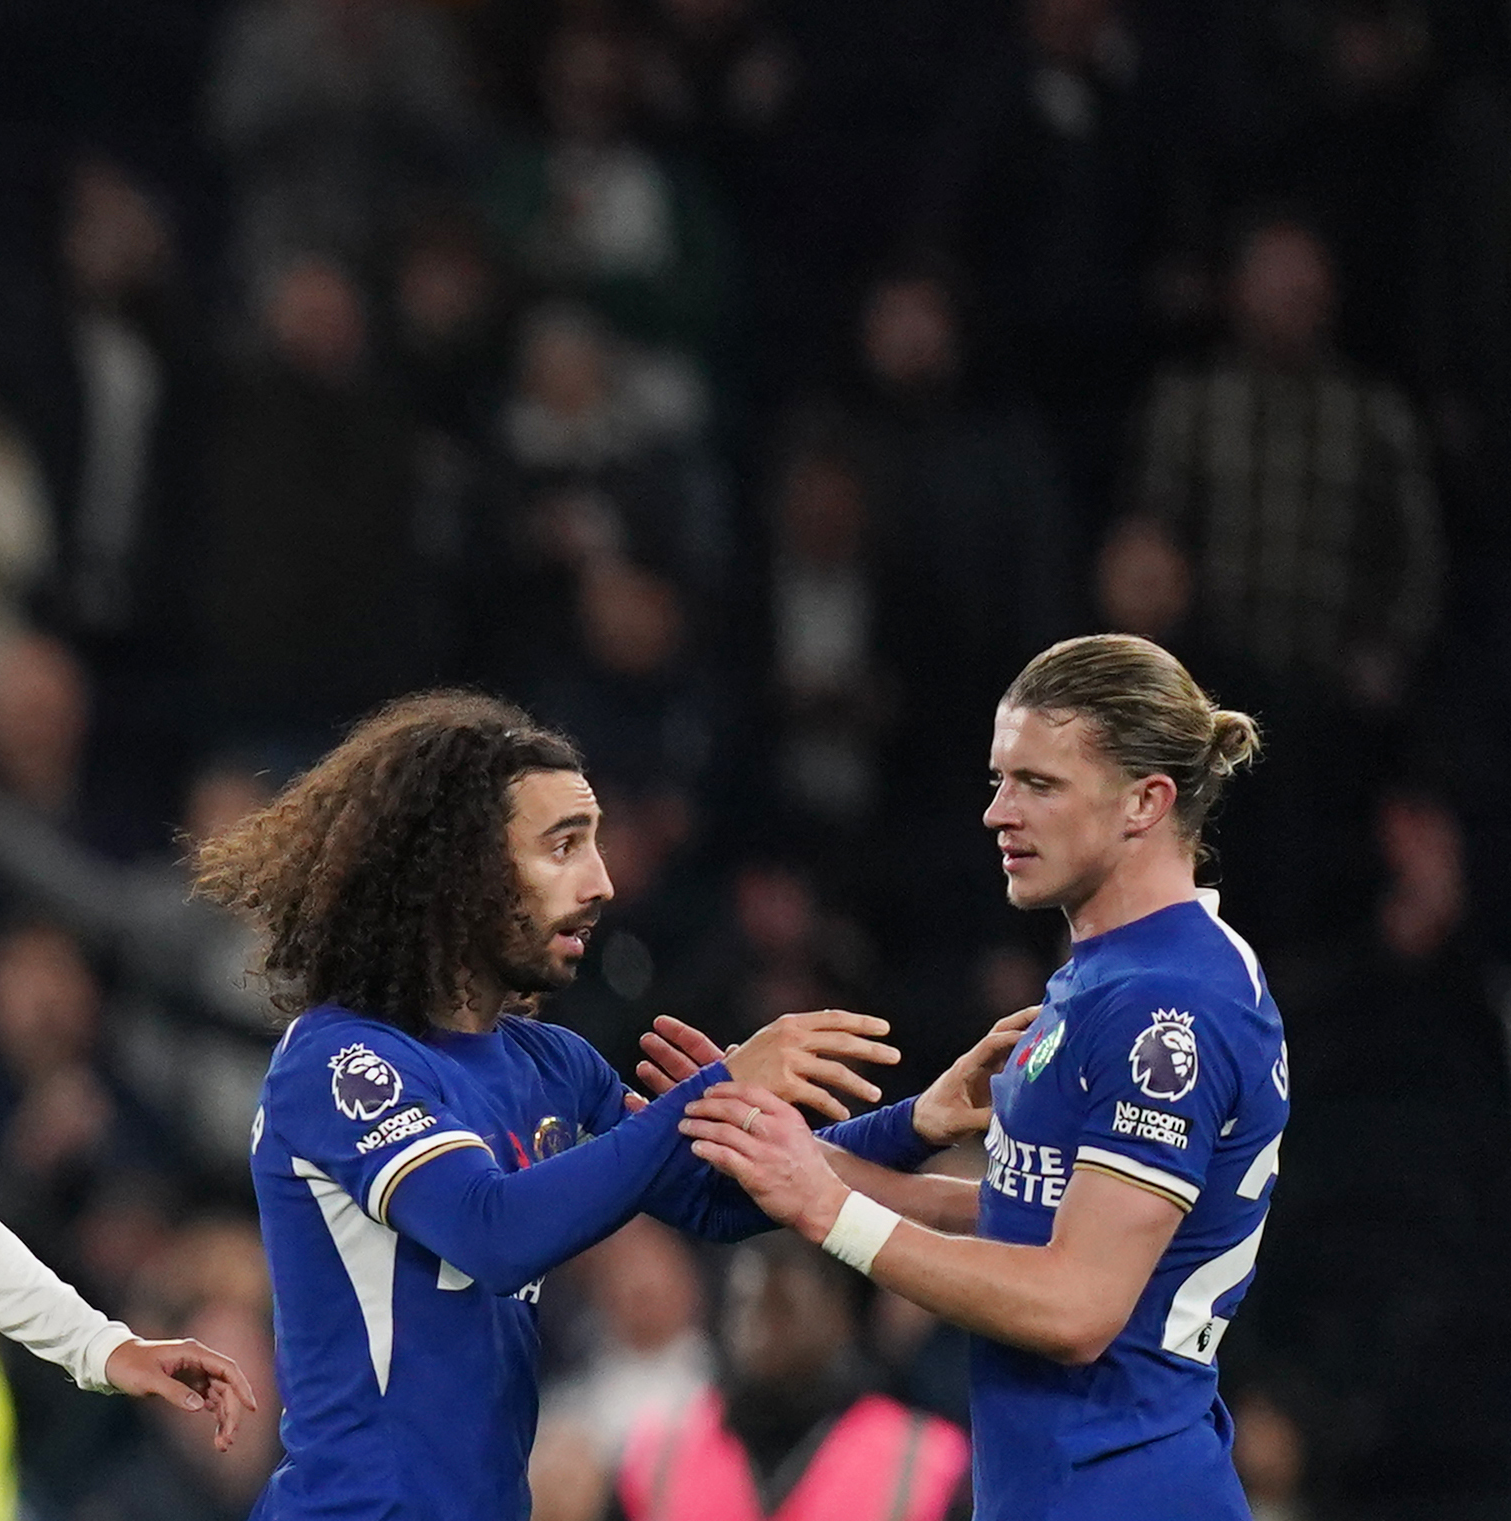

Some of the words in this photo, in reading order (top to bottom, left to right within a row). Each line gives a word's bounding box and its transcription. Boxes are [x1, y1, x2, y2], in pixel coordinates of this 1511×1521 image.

[356, 1131, 382, 1154] No
[378, 1106, 423, 1137] room
[1112, 1114, 1137, 1135] for
[1135, 1122, 1188, 1150] racism
[1114, 1100, 1140, 1120] No
[1140, 1108, 1186, 1134] room
